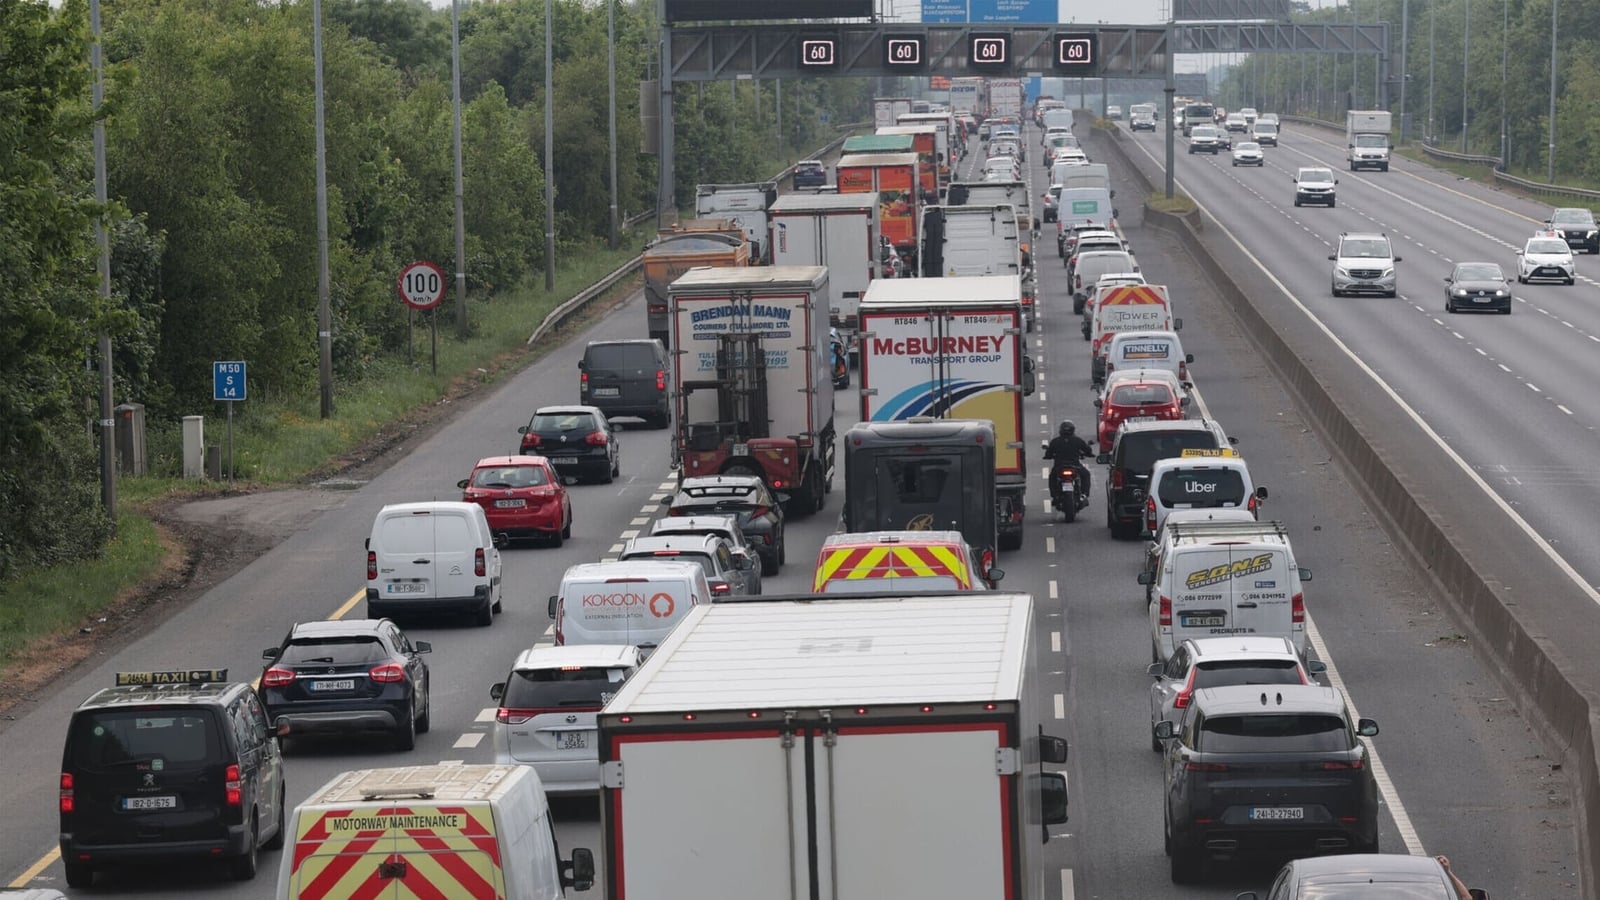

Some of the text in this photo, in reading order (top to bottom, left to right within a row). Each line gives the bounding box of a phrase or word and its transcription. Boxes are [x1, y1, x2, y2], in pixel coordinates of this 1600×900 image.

[811, 46, 826, 59] 60
[896, 45, 911, 58] 60
[982, 44, 997, 57] 60
[1068, 45, 1082, 58] 60
[406, 273, 438, 293] 100
[691, 304, 791, 324] BRENDAN MANN
[1115, 312, 1158, 322] TOWER
[730, 322, 774, 330] (TULLAMORE)
[873, 336, 1005, 355] McBURNEY
[910, 356, 966, 364] TRANSPORT
[226, 376, 233, 385] S
[224, 388, 235, 397] 14
[1185, 481, 1216, 493] Uber
[583, 593, 645, 607] KOKOON
[154, 673, 184, 682] TAXI
[132, 799, 170, 808] 182-D-1675
[1256, 810, 1301, 818] 241-D-27940
[334, 815, 457, 830] MOTORWAY MAINTENANCE
